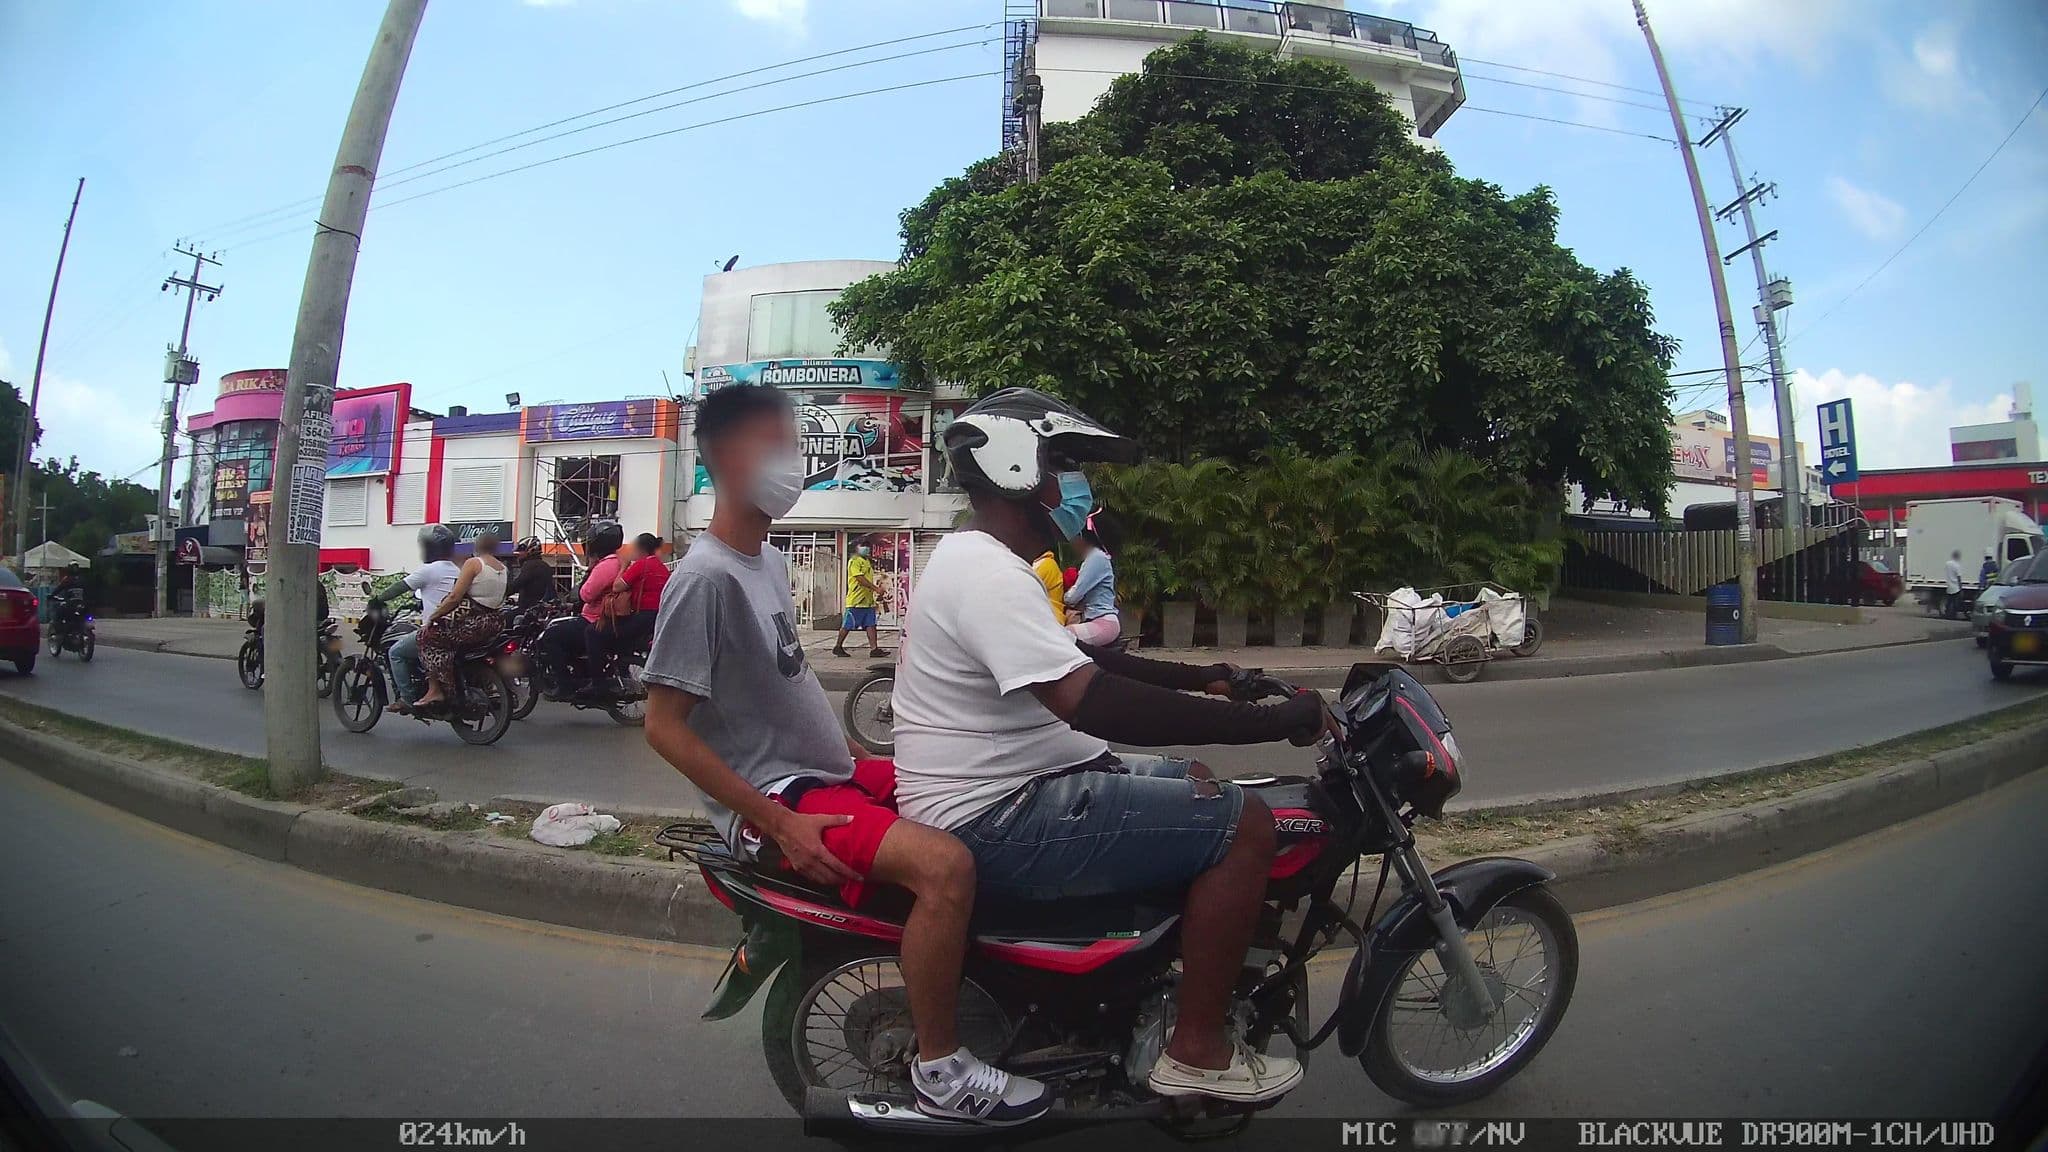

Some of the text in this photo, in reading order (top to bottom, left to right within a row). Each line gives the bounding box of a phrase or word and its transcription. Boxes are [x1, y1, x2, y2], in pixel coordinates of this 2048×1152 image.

[762, 367, 860, 384] BOMBONERA
[1820, 403, 1848, 446] H
[800, 437, 862, 456] ONERA
[1823, 446, 1851, 459] HOTEL
